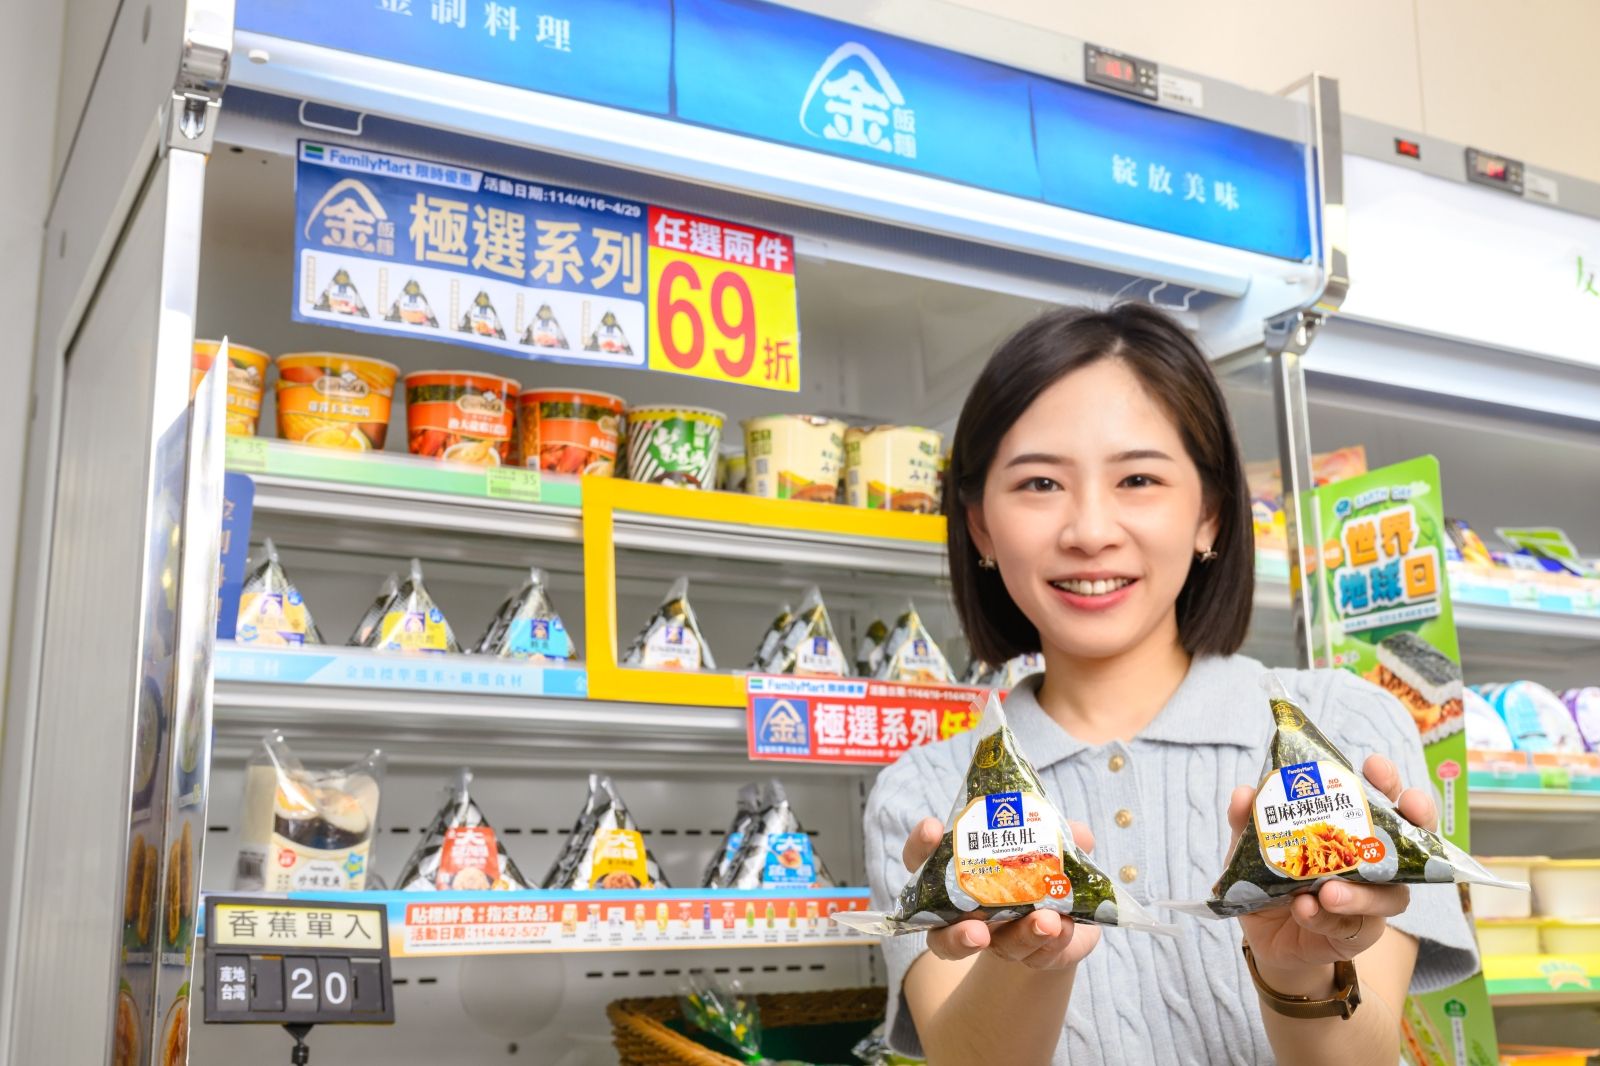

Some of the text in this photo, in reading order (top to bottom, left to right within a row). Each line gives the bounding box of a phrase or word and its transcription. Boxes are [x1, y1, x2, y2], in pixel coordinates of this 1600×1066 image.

[329, 149, 473, 187] FamilyMart 限時優惠
[1111, 153, 1240, 211] 綻放美味
[407, 191, 643, 295] 極選系列
[653, 212, 790, 273] 任選兩件
[1345, 510, 1415, 568] 世界
[767, 679, 828, 696] FamilyMart
[814, 702, 939, 749] 極選系列
[1278, 793, 1354, 821] 麻辣鯖魚
[982, 828, 1036, 849] 鮭魚肚
[228, 910, 372, 940] 香蕉單入
[220, 965, 247, 983] 產地
[221, 983, 247, 1002] 台灣
[290, 967, 348, 1006] 20
